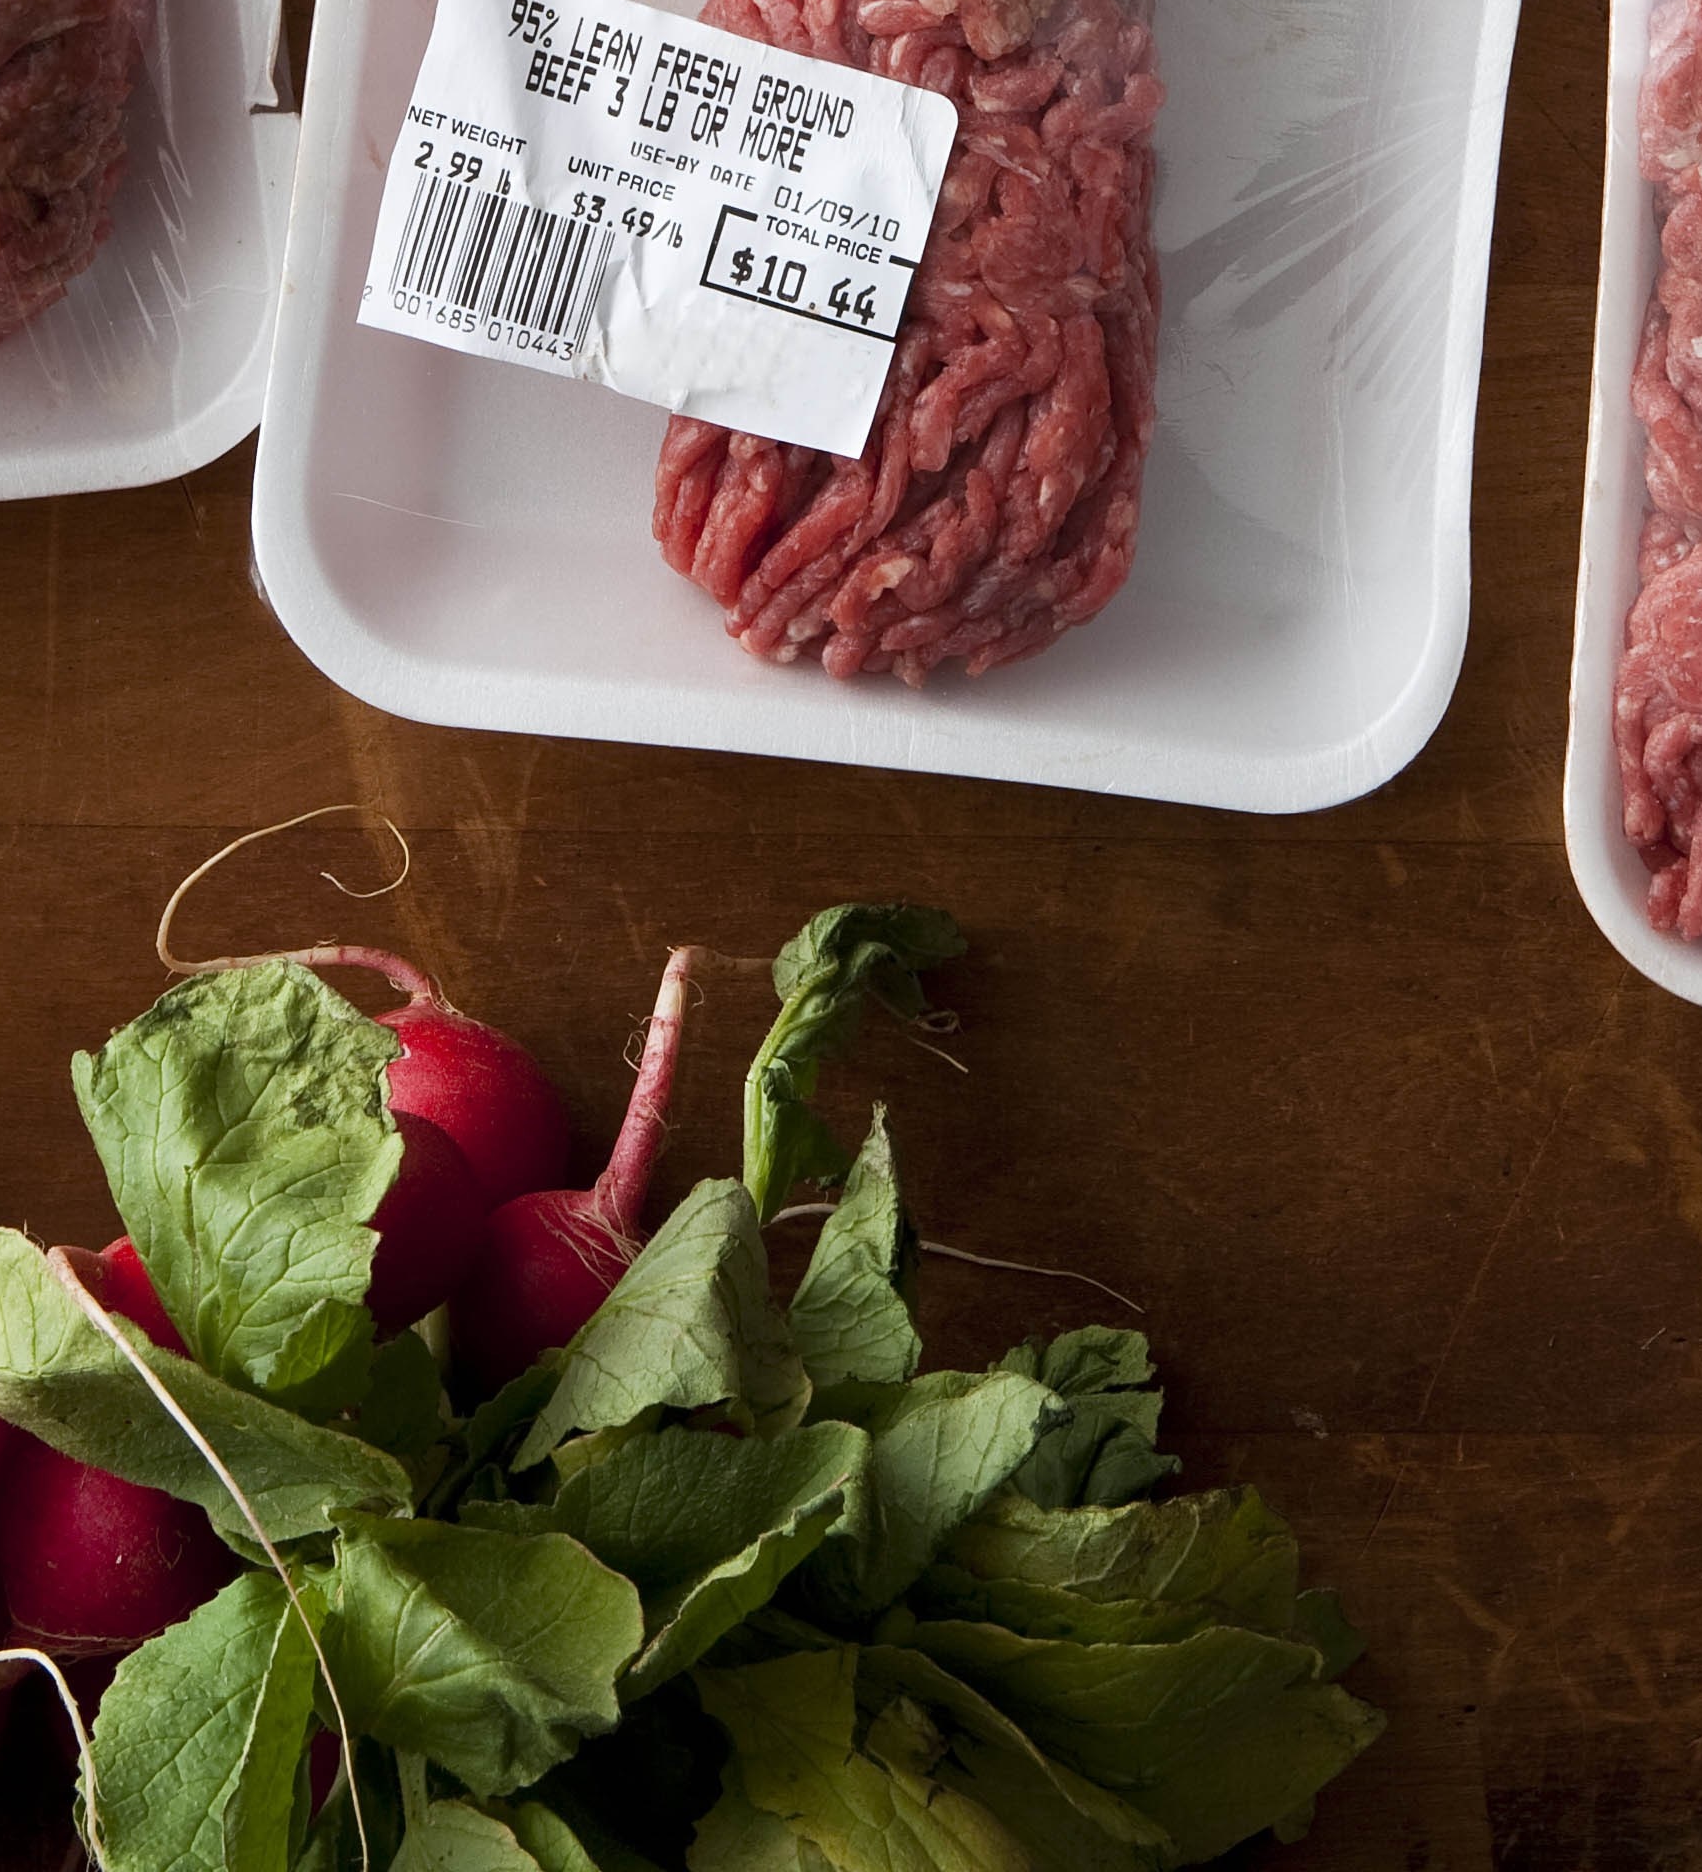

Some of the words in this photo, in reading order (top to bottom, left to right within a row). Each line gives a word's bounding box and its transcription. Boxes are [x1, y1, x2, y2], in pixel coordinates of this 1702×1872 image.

[569, 17, 642, 73] LEAN
[652, 43, 741, 104] FRESH
[752, 74, 853, 138] GROUND
[408, 106, 447, 129] NET
[450, 117, 527, 156] WEIGHT
[525, 51, 598, 105] BEEF
[607, 78, 630, 118] 3
[639, 85, 679, 134] LB
[691, 103, 728, 148] OR
[740, 116, 812, 172] MORE
[414, 142, 483, 182] 2.99
[496, 169, 511, 193] lb
[568, 156, 615, 188] UNIT
[617, 170, 676, 201] PRICE
[631, 142, 699, 175] USE-BY
[710, 165, 756, 193] DATE
[773, 186, 900, 242] 01/09/10
[573, 191, 683, 249] $3.49/lb
[764, 215, 821, 247] TOTAL
[824, 231, 882, 264] PRICE
[730, 248, 876, 325] $10.44
[393, 290, 477, 333] 001685
[488, 321, 575, 361] 010443
